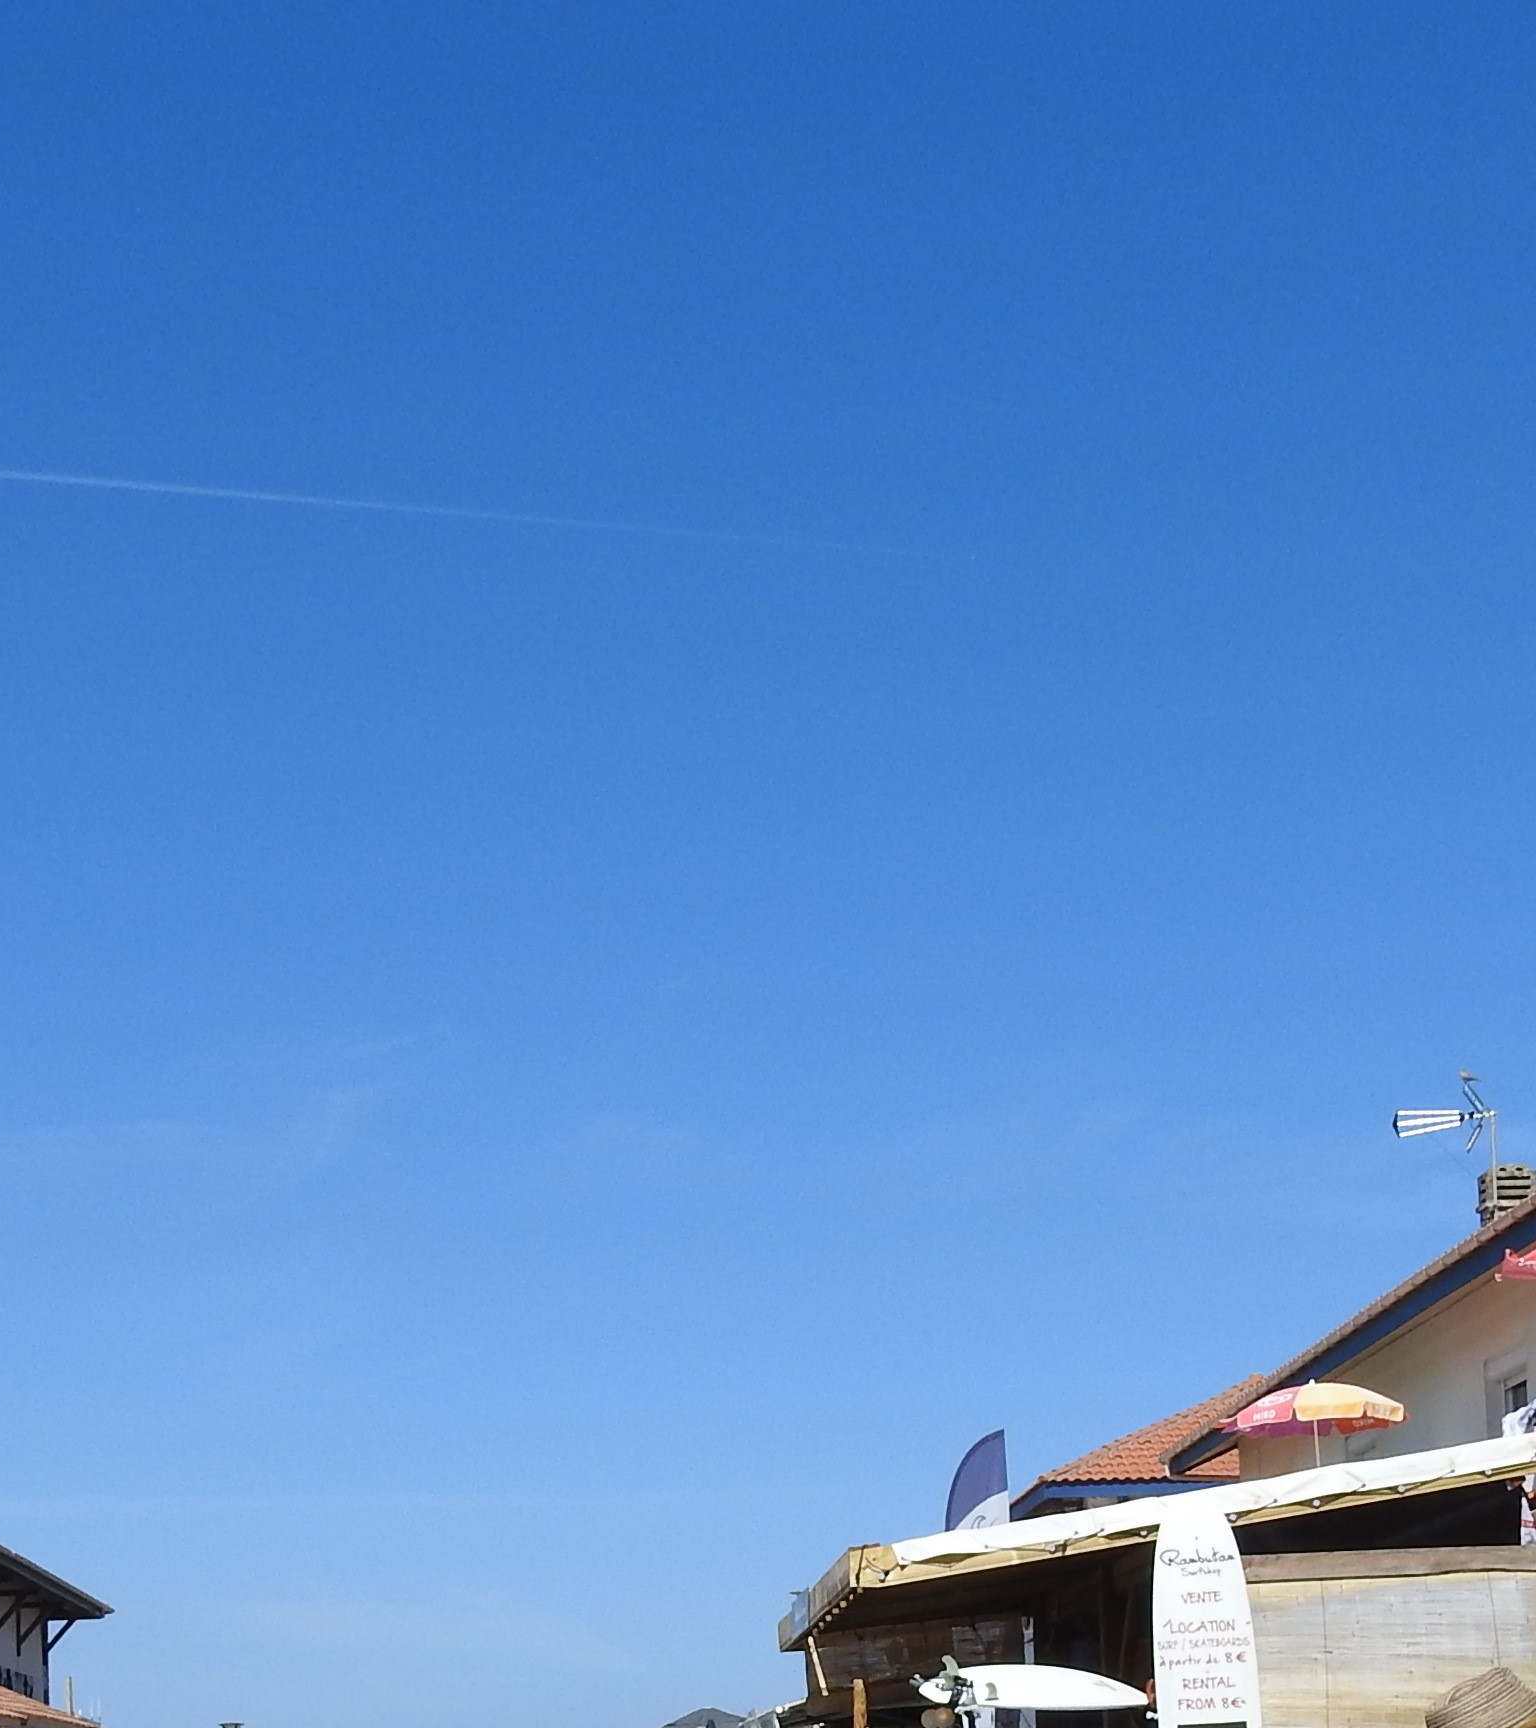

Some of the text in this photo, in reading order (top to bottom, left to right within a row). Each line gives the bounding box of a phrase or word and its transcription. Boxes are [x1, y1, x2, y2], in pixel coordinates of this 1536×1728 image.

[1180, 1590, 1224, 1604] VENTE
[1163, 1619, 1235, 1634] LOCATION
[1168, 1654, 1201, 1671] partir
[1205, 1653, 1219, 1664] de
[1182, 1676, 1236, 1690] RENTAL
[1177, 1697, 1216, 1710] FROM
